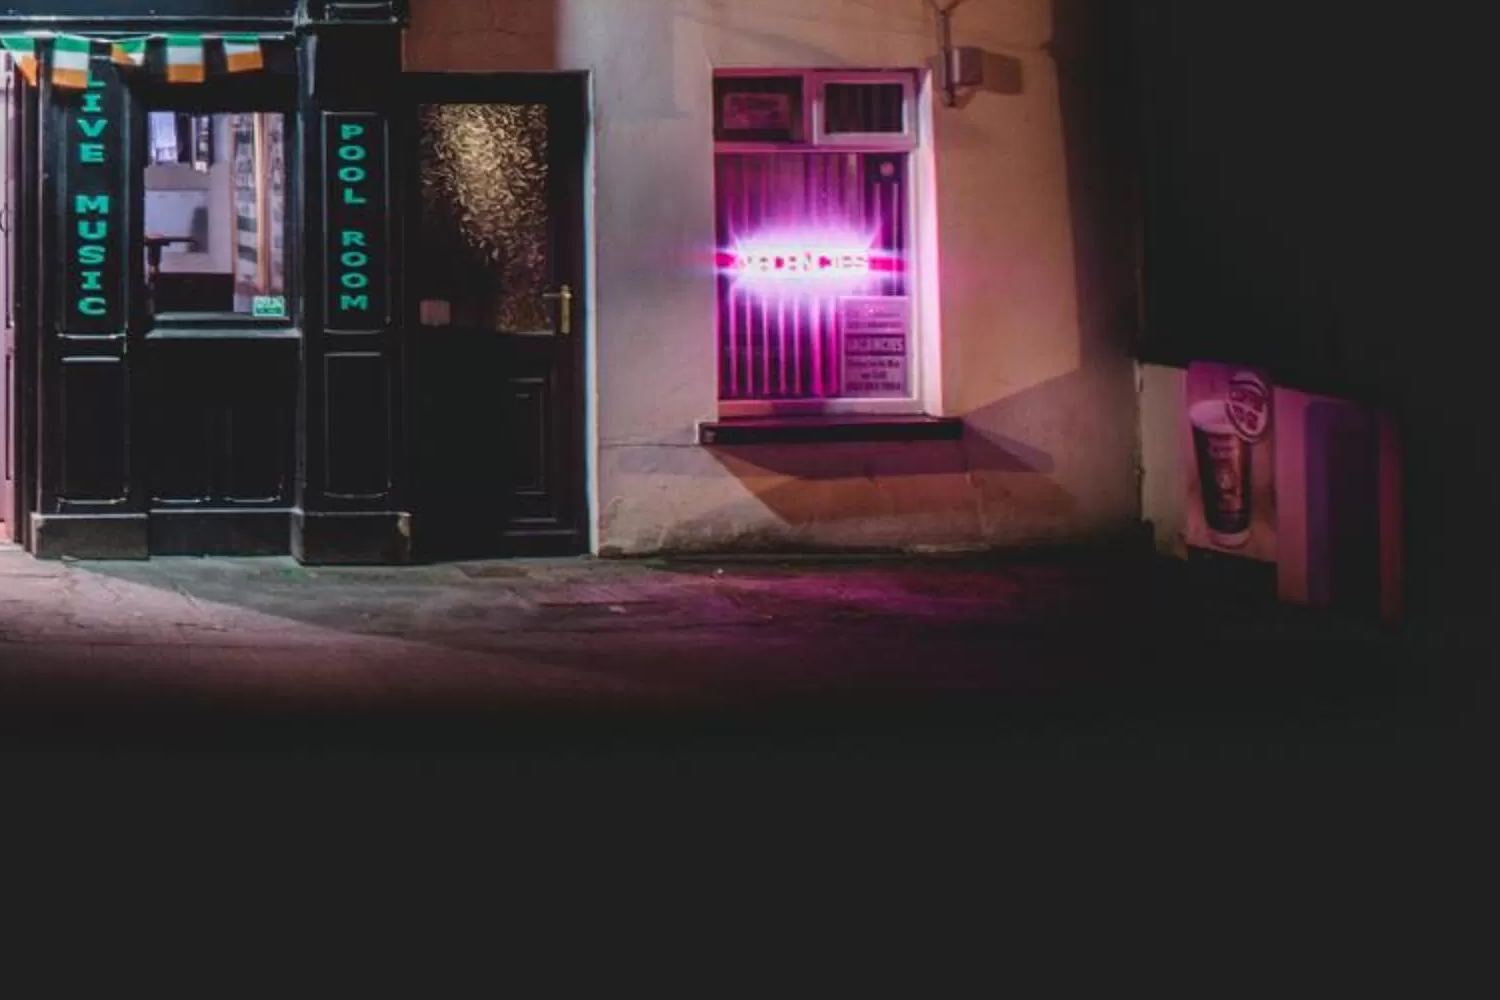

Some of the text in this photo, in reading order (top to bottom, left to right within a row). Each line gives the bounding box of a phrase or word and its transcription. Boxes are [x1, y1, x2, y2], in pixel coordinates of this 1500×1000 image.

[74, 71, 110, 315] LIVE MUSIC
[337, 123, 369, 311] POOL ROOM
